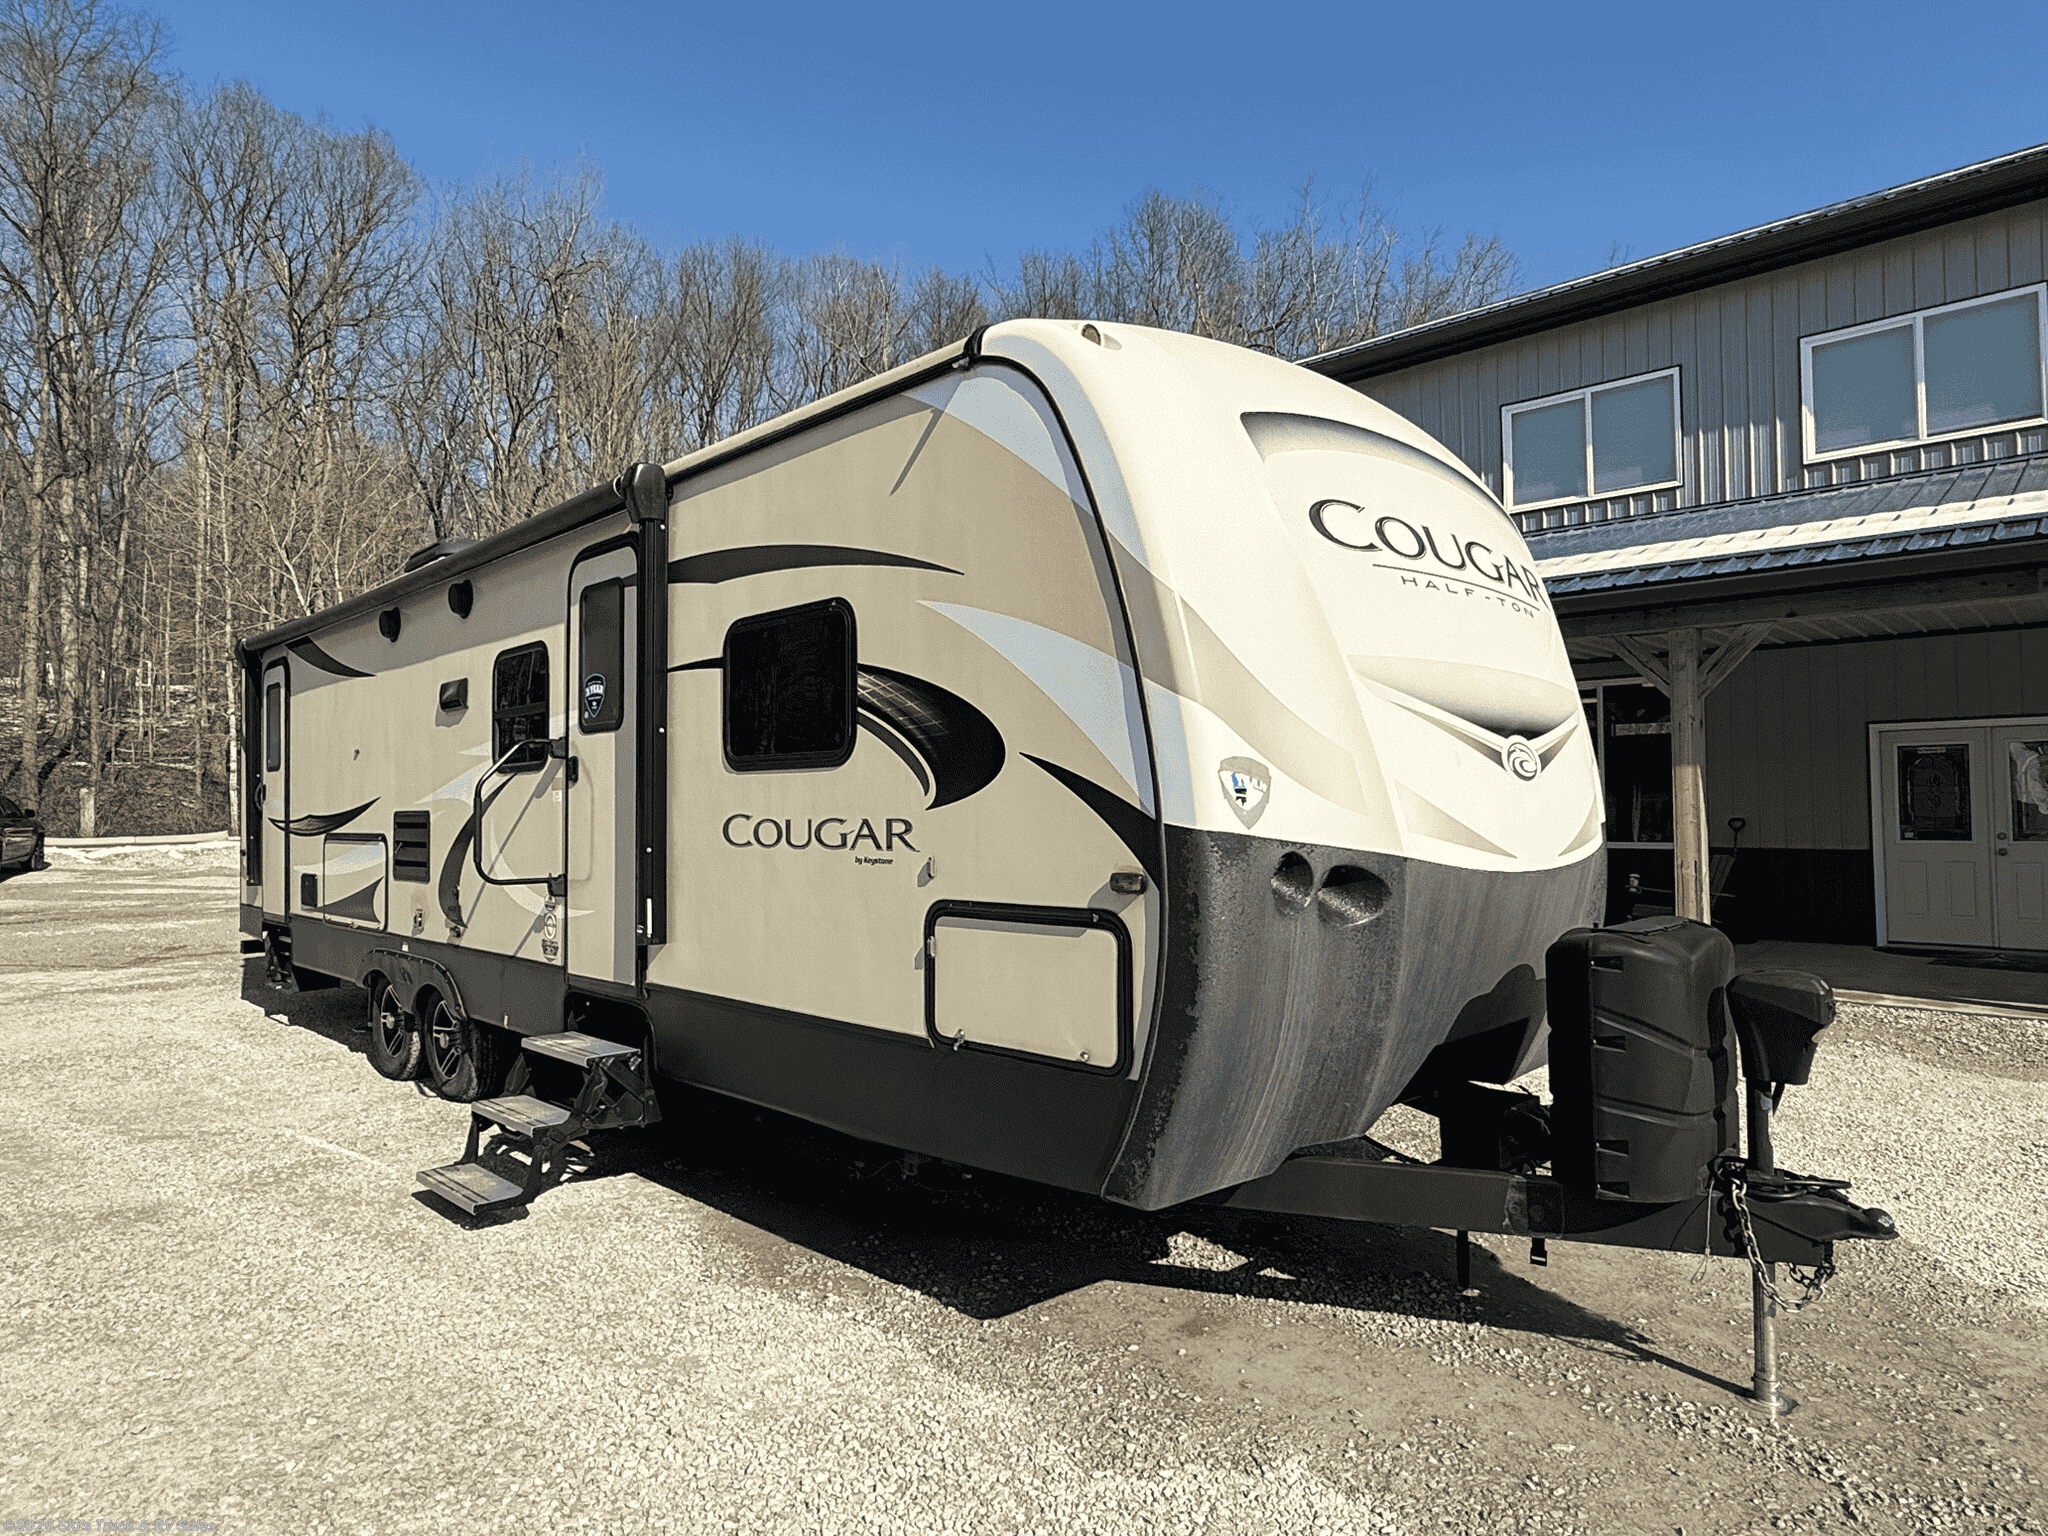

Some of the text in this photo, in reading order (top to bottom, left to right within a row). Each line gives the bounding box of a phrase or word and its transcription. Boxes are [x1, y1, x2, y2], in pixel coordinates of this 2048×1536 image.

[1308, 498, 1550, 611] COUGAR
[1400, 575, 1535, 619] HALF-TON
[722, 813, 921, 853] COUGAR
[854, 855, 894, 866] by Keystone
